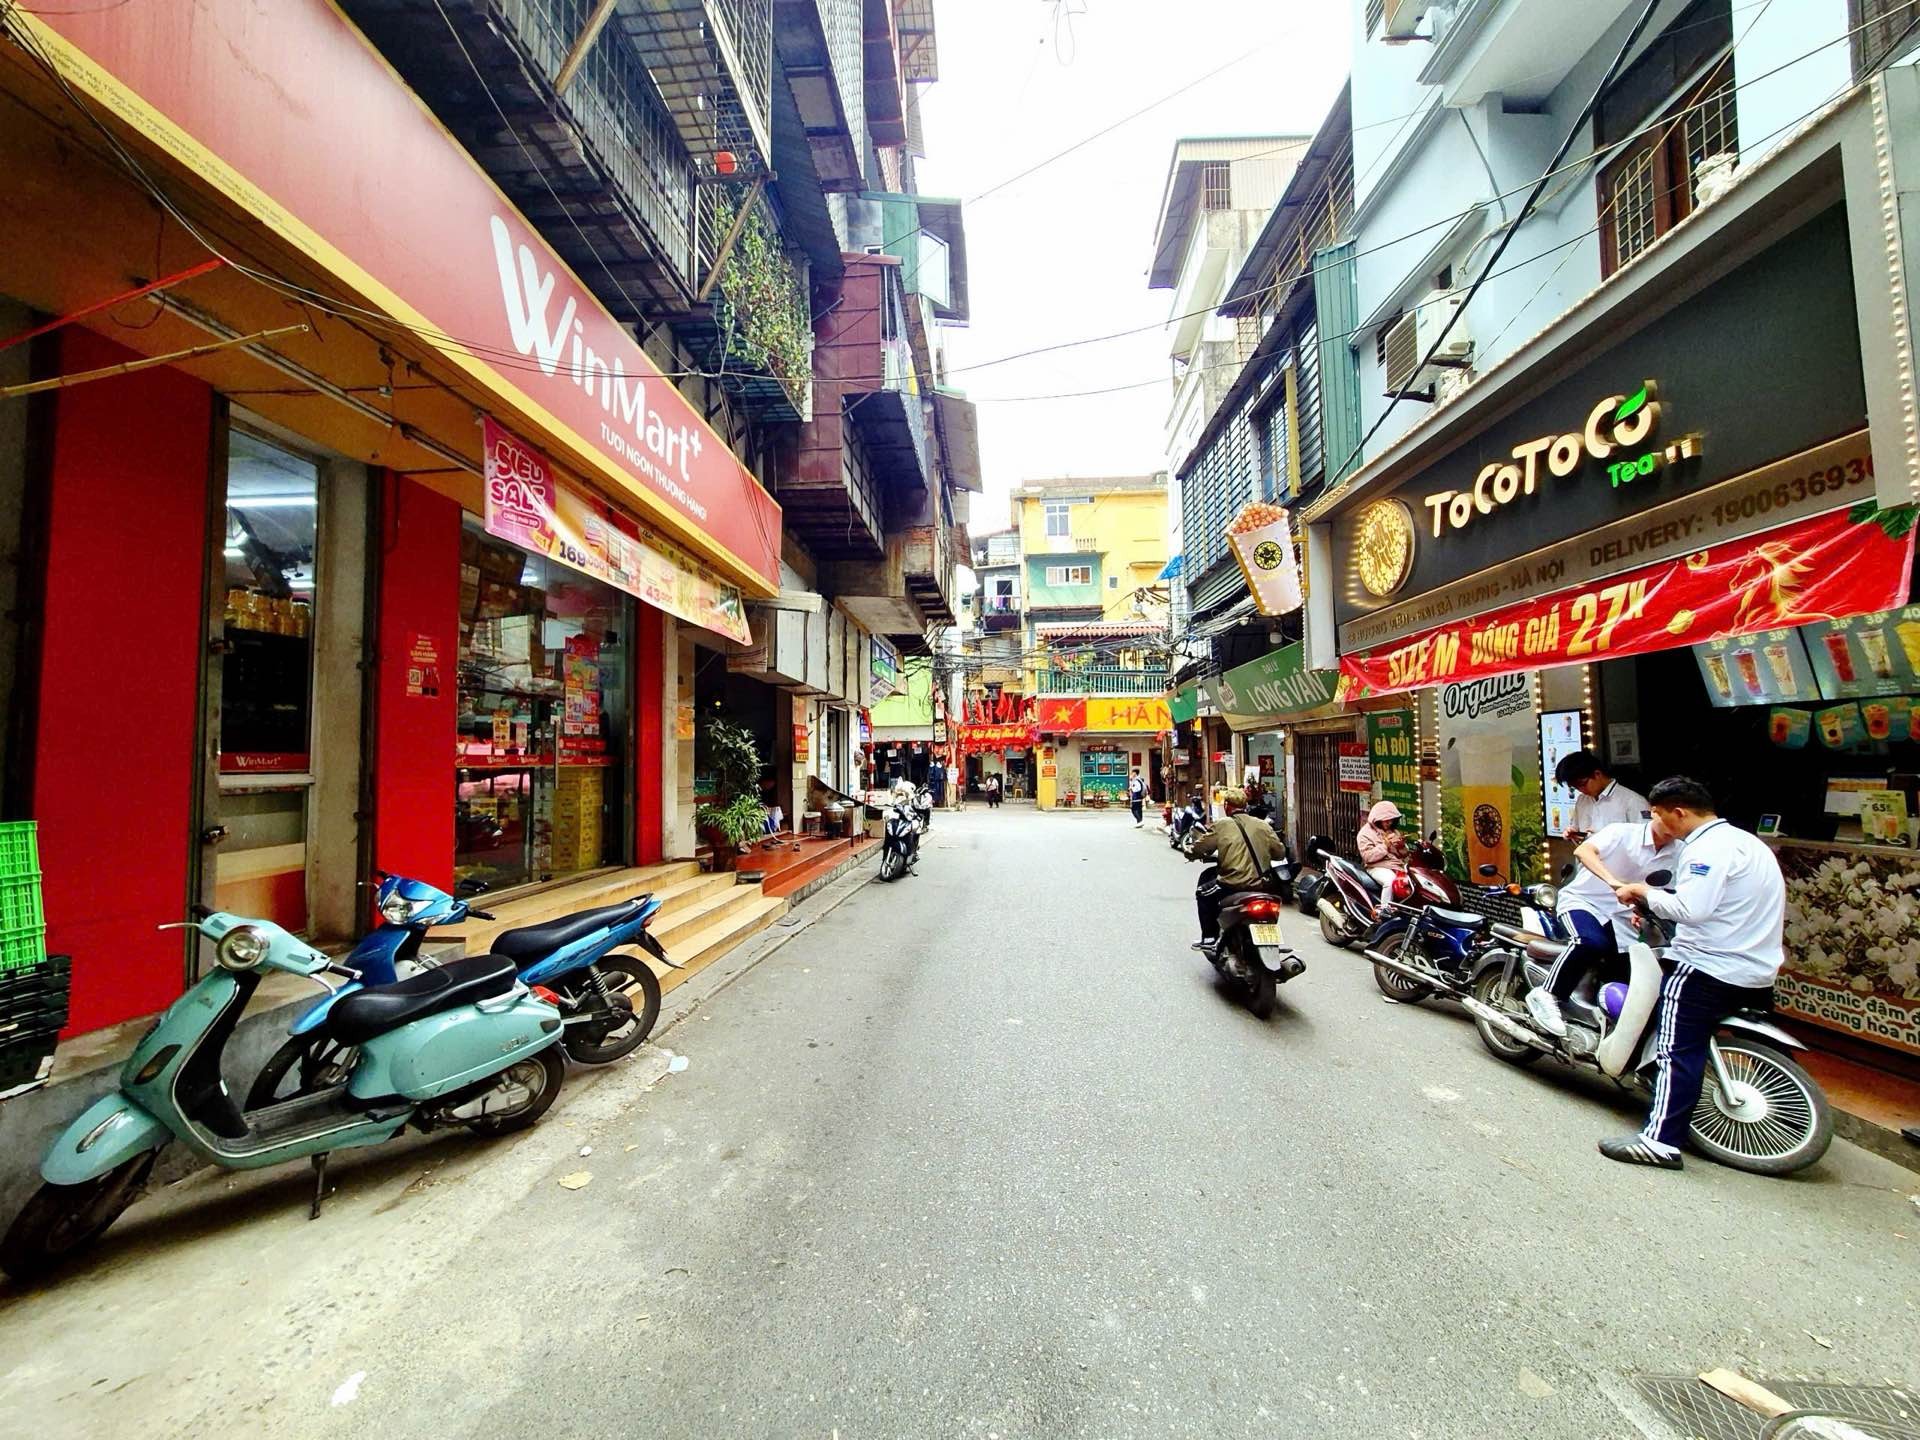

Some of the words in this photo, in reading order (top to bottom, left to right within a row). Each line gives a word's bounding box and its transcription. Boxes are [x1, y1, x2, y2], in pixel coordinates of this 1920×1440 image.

[626, 444, 654, 478] NGON
[1607, 453, 1655, 488] Tea
[1388, 638, 1430, 688] SIZE
[1431, 629, 1460, 678] M
[1523, 602, 1560, 657] GIÁ
[1246, 680, 1293, 712] LONG
[1283, 667, 1330, 704] VÂN
[1375, 733, 1388, 756] GÀ
[1795, 998, 1816, 1014] trà
[1821, 1006, 1861, 1030] cùng
[1867, 1017, 1899, 1038] hoa
[1800, 983, 1861, 1009] organic
[1866, 999, 1905, 1021] đậm
